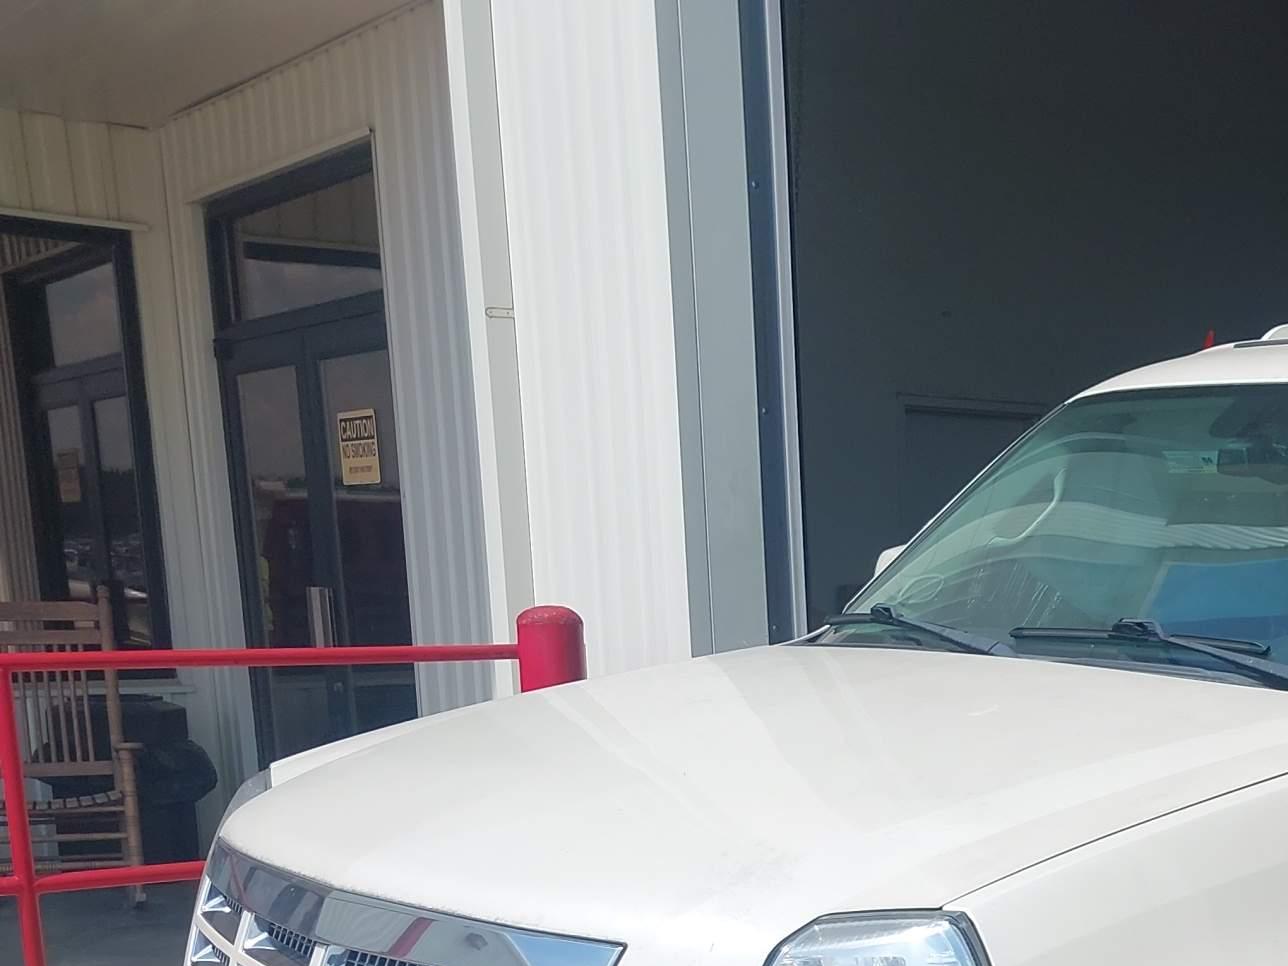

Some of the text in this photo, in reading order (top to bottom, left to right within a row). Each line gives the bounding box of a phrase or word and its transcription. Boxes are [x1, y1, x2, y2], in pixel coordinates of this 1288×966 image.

[340, 418, 374, 440] CAUTION
[342, 441, 377, 459] NO SMOKING
